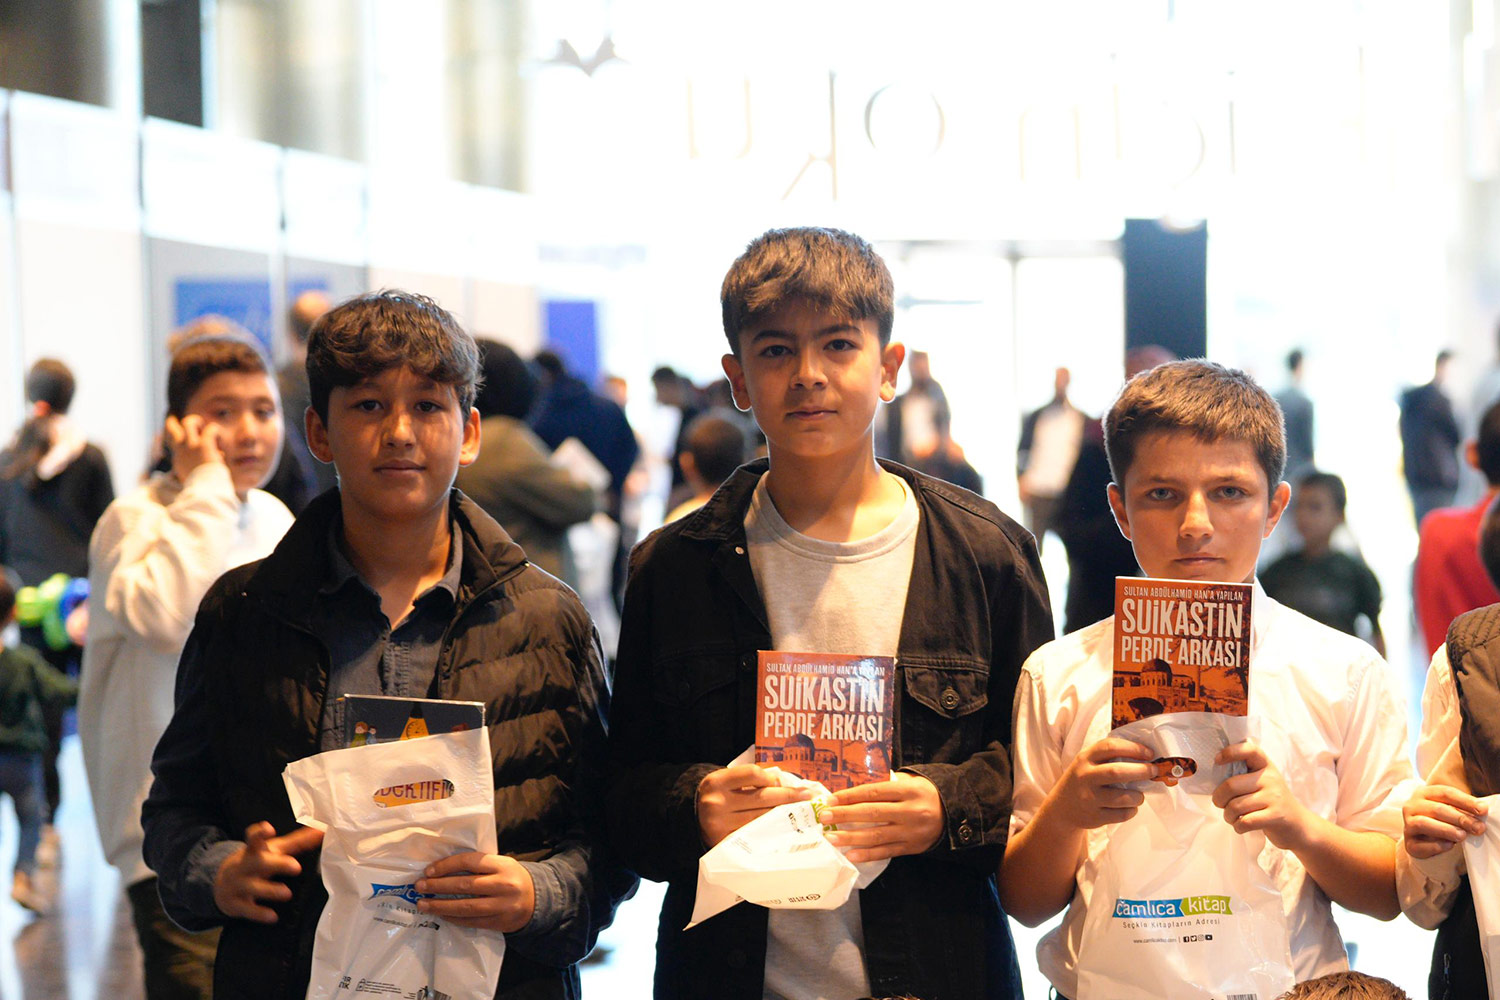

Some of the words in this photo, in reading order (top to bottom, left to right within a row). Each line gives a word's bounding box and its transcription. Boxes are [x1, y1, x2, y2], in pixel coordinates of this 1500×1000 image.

[1123, 586, 1148, 596] SULTAN
[1194, 589, 1215, 600] HAN'A
[1216, 591, 1243, 601] YAPILAN
[1121, 598, 1243, 638] SUİKASTİN
[1121, 636, 1173, 664] PERDE
[1178, 639, 1241, 667] ARKASI
[766, 662, 791, 673] SULTAN
[764, 674, 885, 713] SUİKASTİN
[763, 711, 816, 739] PERDE
[820, 714, 883, 741] ARKASI
[1188, 896, 1227, 914] kitap
[1123, 921, 1148, 930] Seçkin
[1151, 919, 1192, 929] Kitapların
[1196, 918, 1221, 926] Adresi
